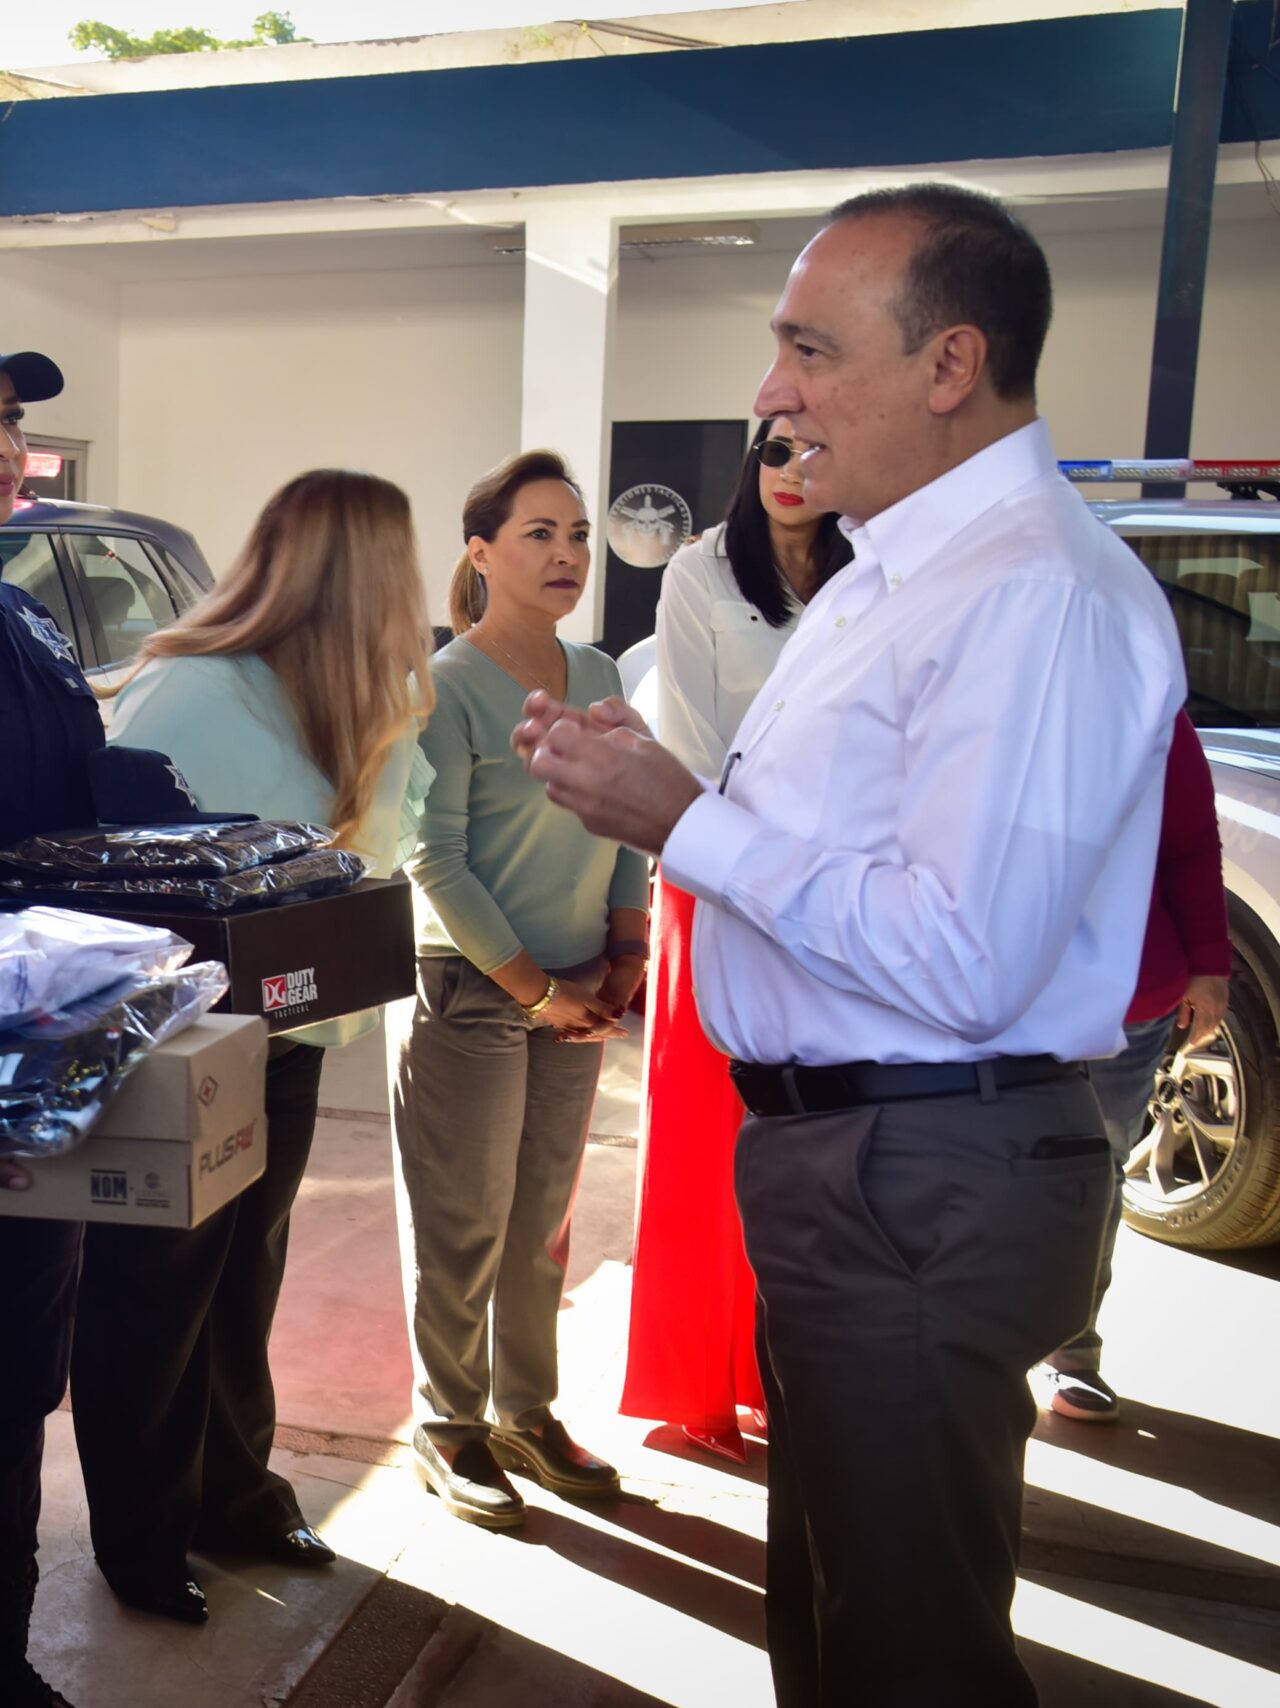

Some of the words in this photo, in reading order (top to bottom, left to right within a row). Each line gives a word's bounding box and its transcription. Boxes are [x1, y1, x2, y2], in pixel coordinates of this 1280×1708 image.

[286, 967, 315, 988] DUTY
[287, 983, 318, 1006] GEAR
[274, 1004, 310, 1020] TACTICAL
[91, 1174, 127, 1200] NOM
